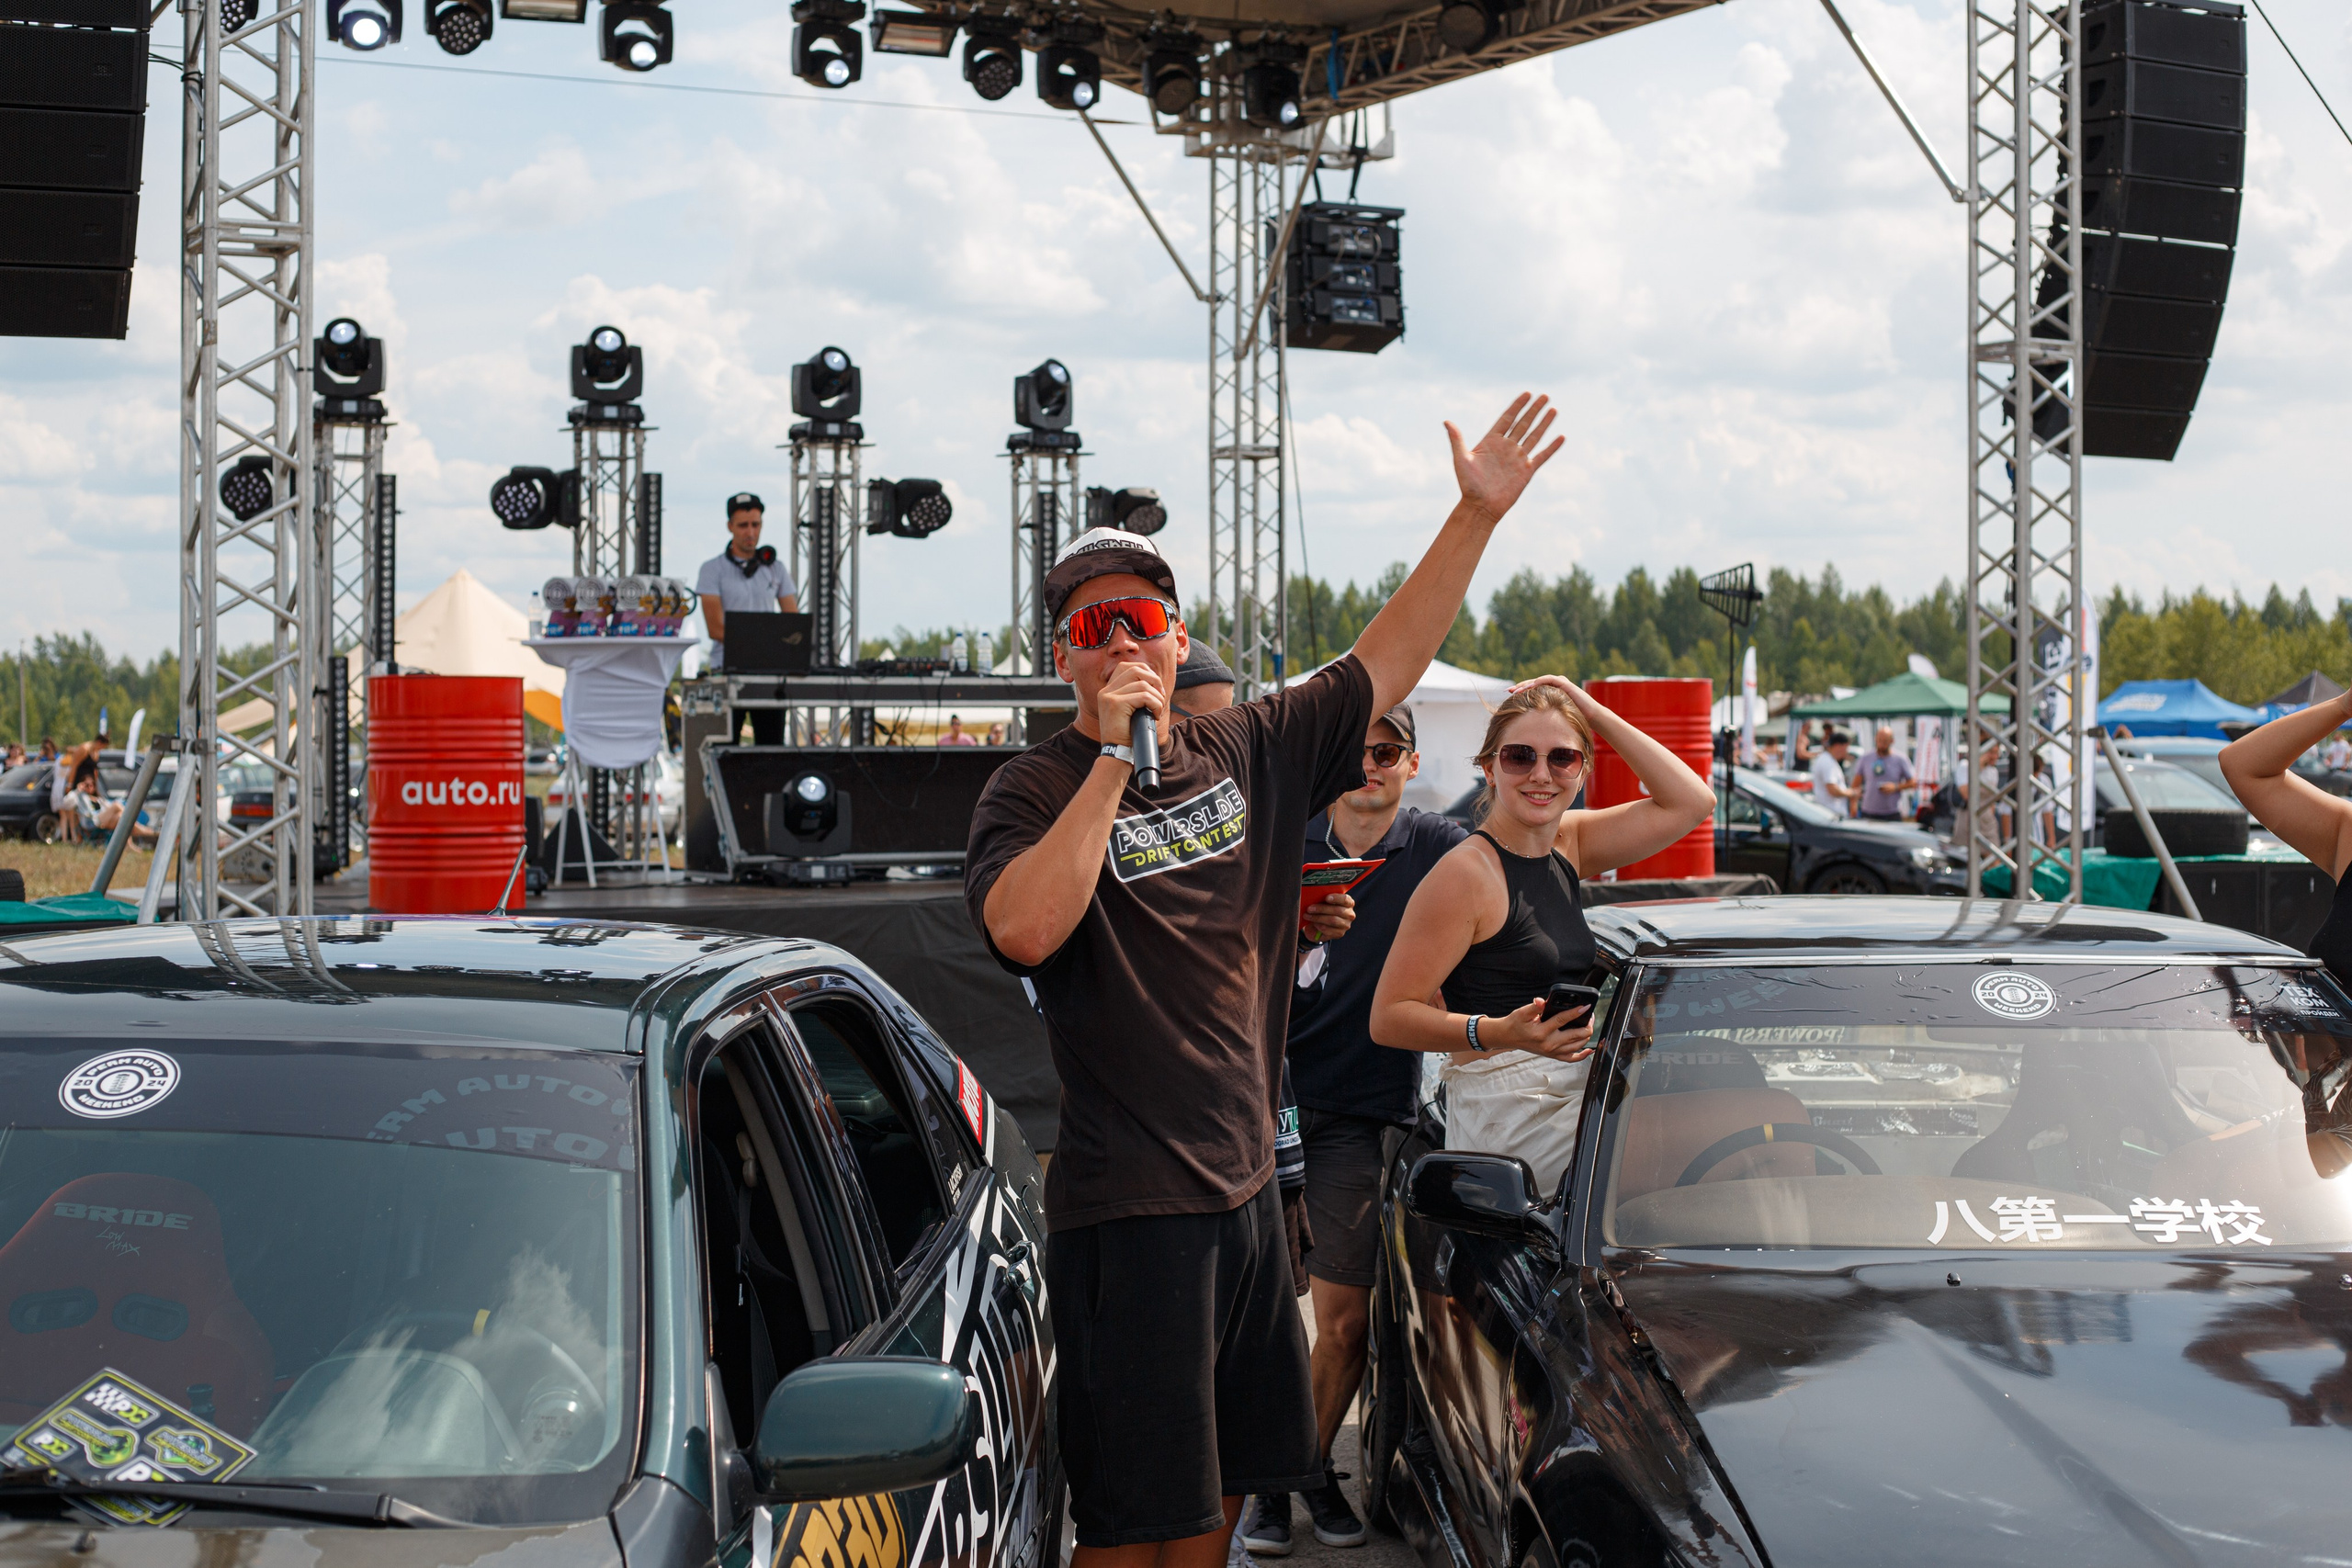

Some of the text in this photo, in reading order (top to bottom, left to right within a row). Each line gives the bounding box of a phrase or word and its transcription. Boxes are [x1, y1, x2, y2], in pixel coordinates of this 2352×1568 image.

[401, 776, 520, 806] auto.ru
[1116, 788, 1244, 854] POWERSLDE
[1984, 976, 2041, 991] PERM AUTO
[1994, 1002, 2041, 1014] WEEKEND
[2290, 997, 2330, 1008] КОМ
[86, 1057, 164, 1077] PERM AUTO
[78, 1093, 145, 1109] WEEKEND
[54, 1201, 195, 1231] BRIDE
[1927, 1196, 2273, 1246] 八第一学校
